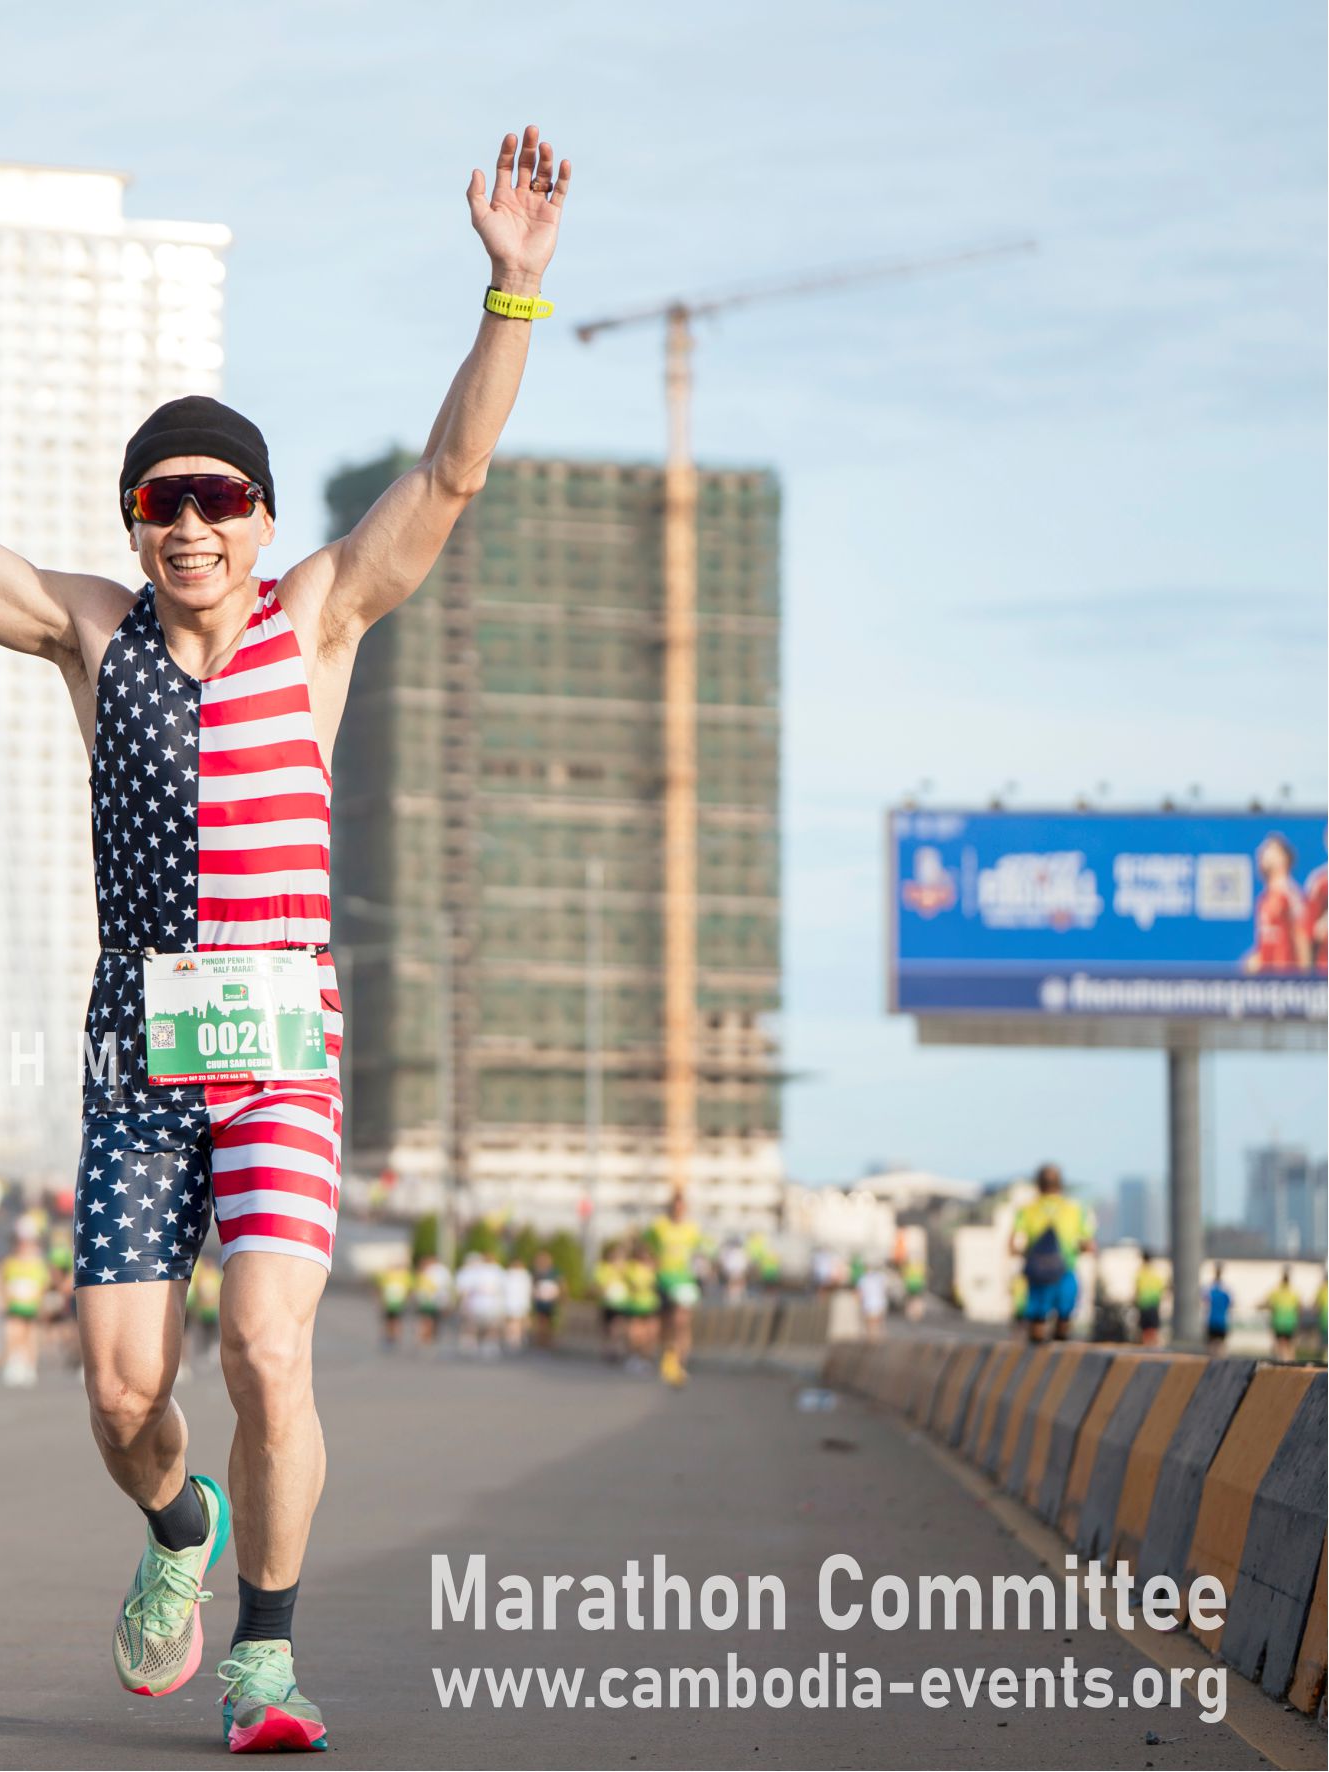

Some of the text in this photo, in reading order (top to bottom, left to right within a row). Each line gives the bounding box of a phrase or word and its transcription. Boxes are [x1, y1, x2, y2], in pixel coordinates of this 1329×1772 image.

[201, 957, 226, 965] PHNOM
[227, 956, 245, 964] PENH
[213, 965, 231, 974] HALF
[206, 1060, 229, 1069] CHUM
[229, 1059, 247, 1068] SAM
